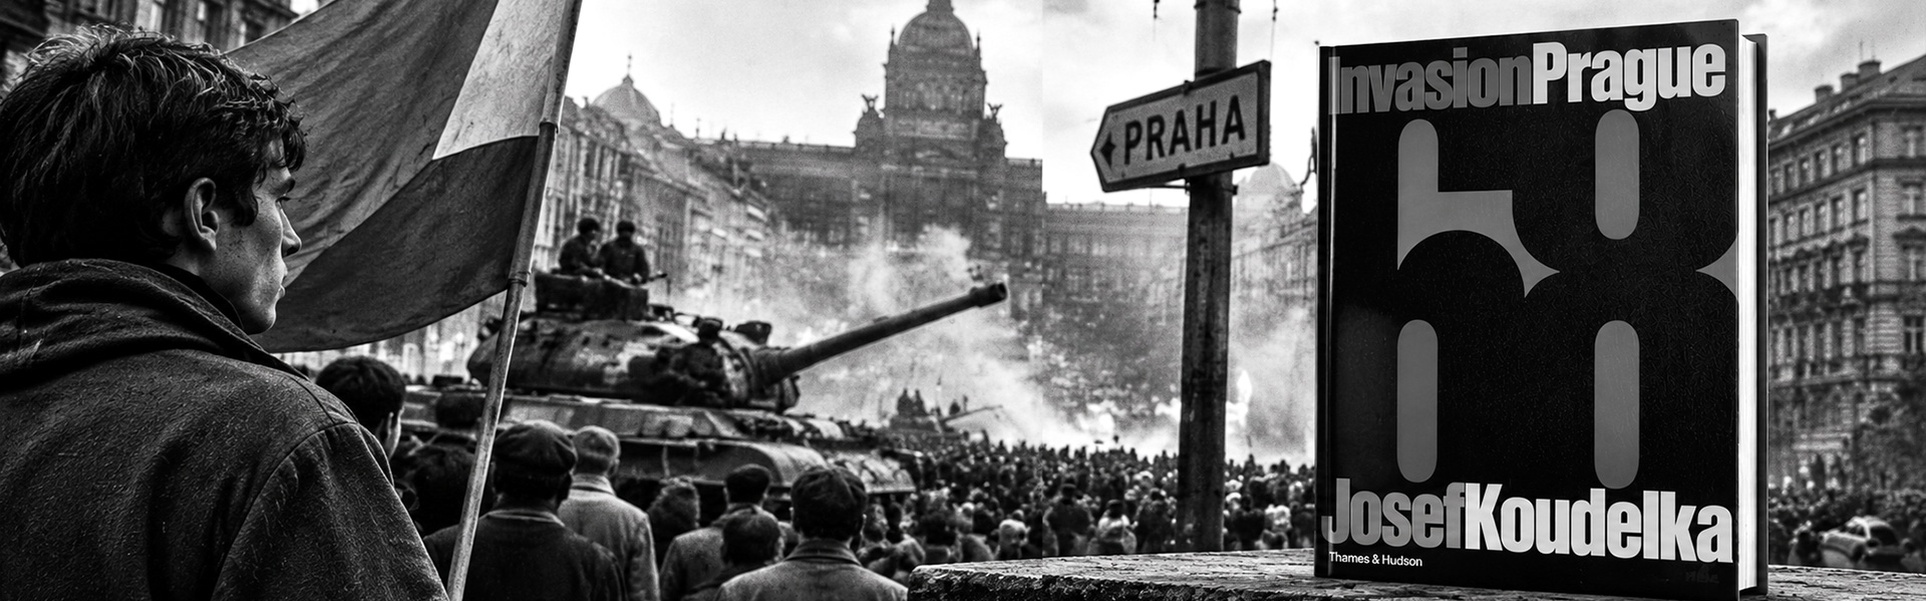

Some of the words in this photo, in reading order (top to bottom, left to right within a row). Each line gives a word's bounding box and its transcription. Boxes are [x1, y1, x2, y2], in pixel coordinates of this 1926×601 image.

[1124, 95, 1246, 165] PRAHA
[1329, 551, 1370, 564] Thames
[1372, 554, 1380, 565] &
[1382, 554, 1423, 567] Hudson
